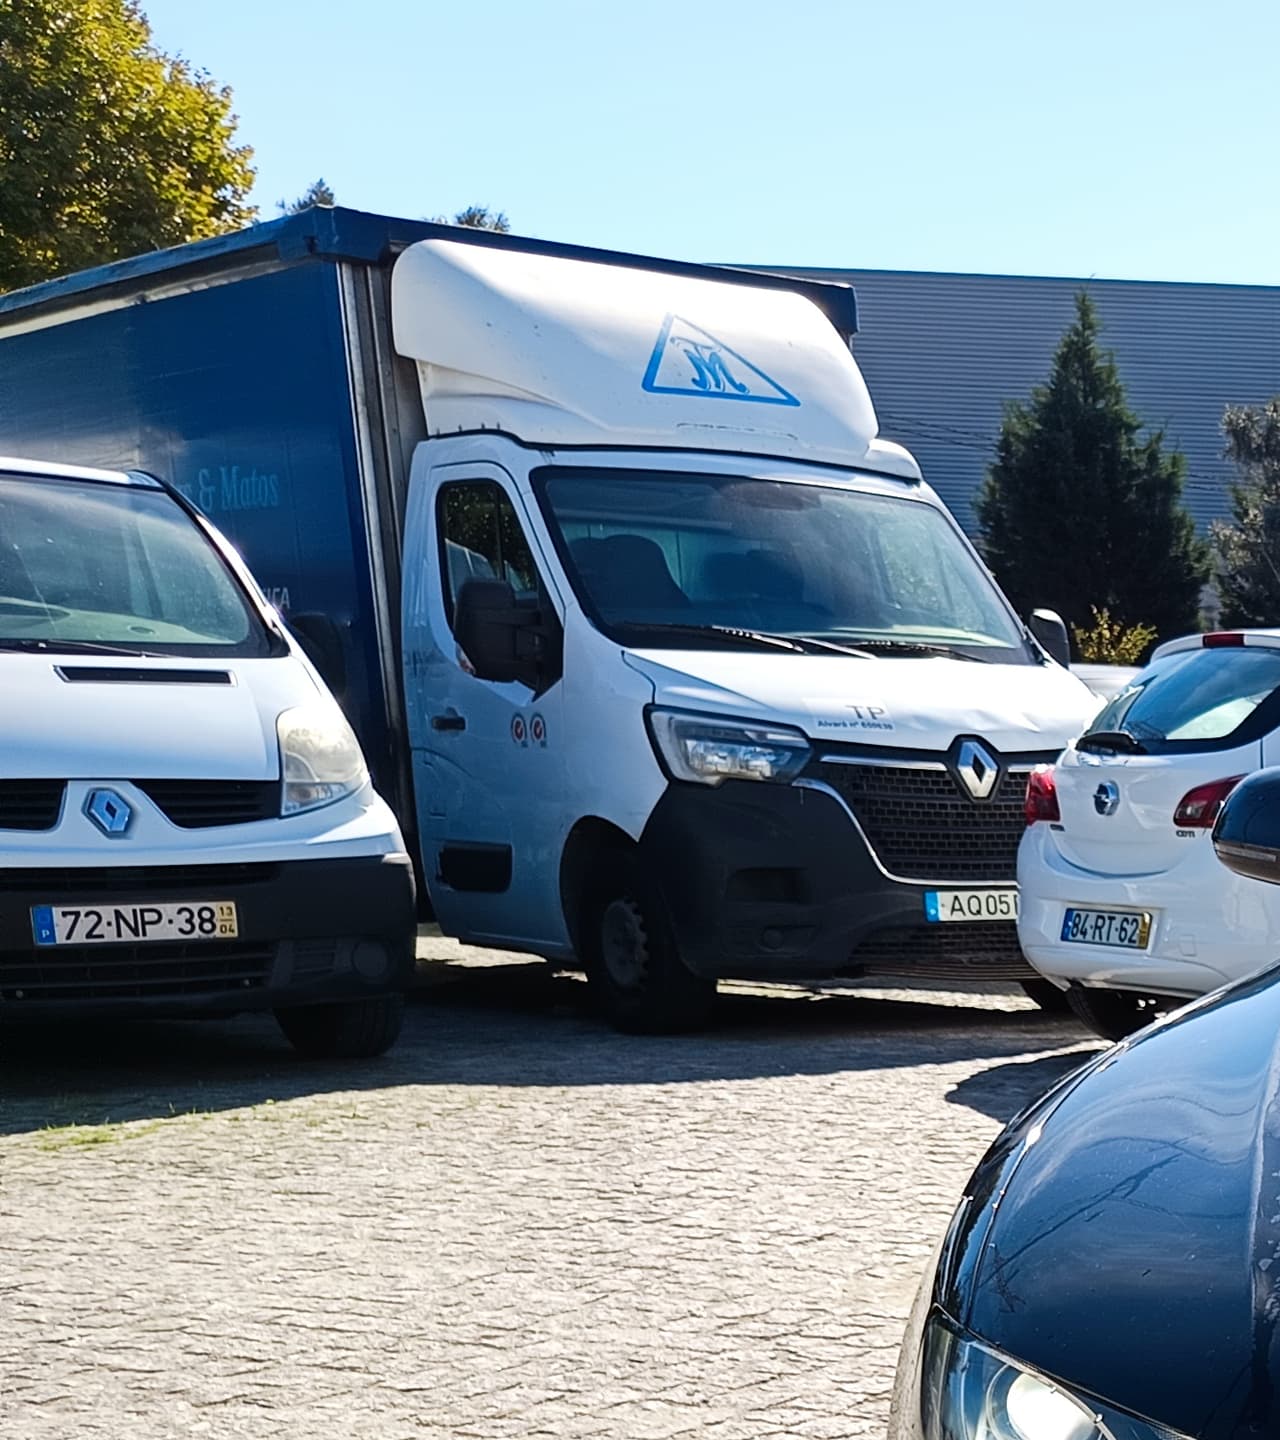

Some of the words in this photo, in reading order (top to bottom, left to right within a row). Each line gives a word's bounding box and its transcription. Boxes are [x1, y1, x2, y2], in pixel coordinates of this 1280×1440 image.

[219, 466, 279, 511] Matos
[845, 705, 885, 720] TP
[219, 906, 233, 916] 13
[219, 924, 235, 934] 04
